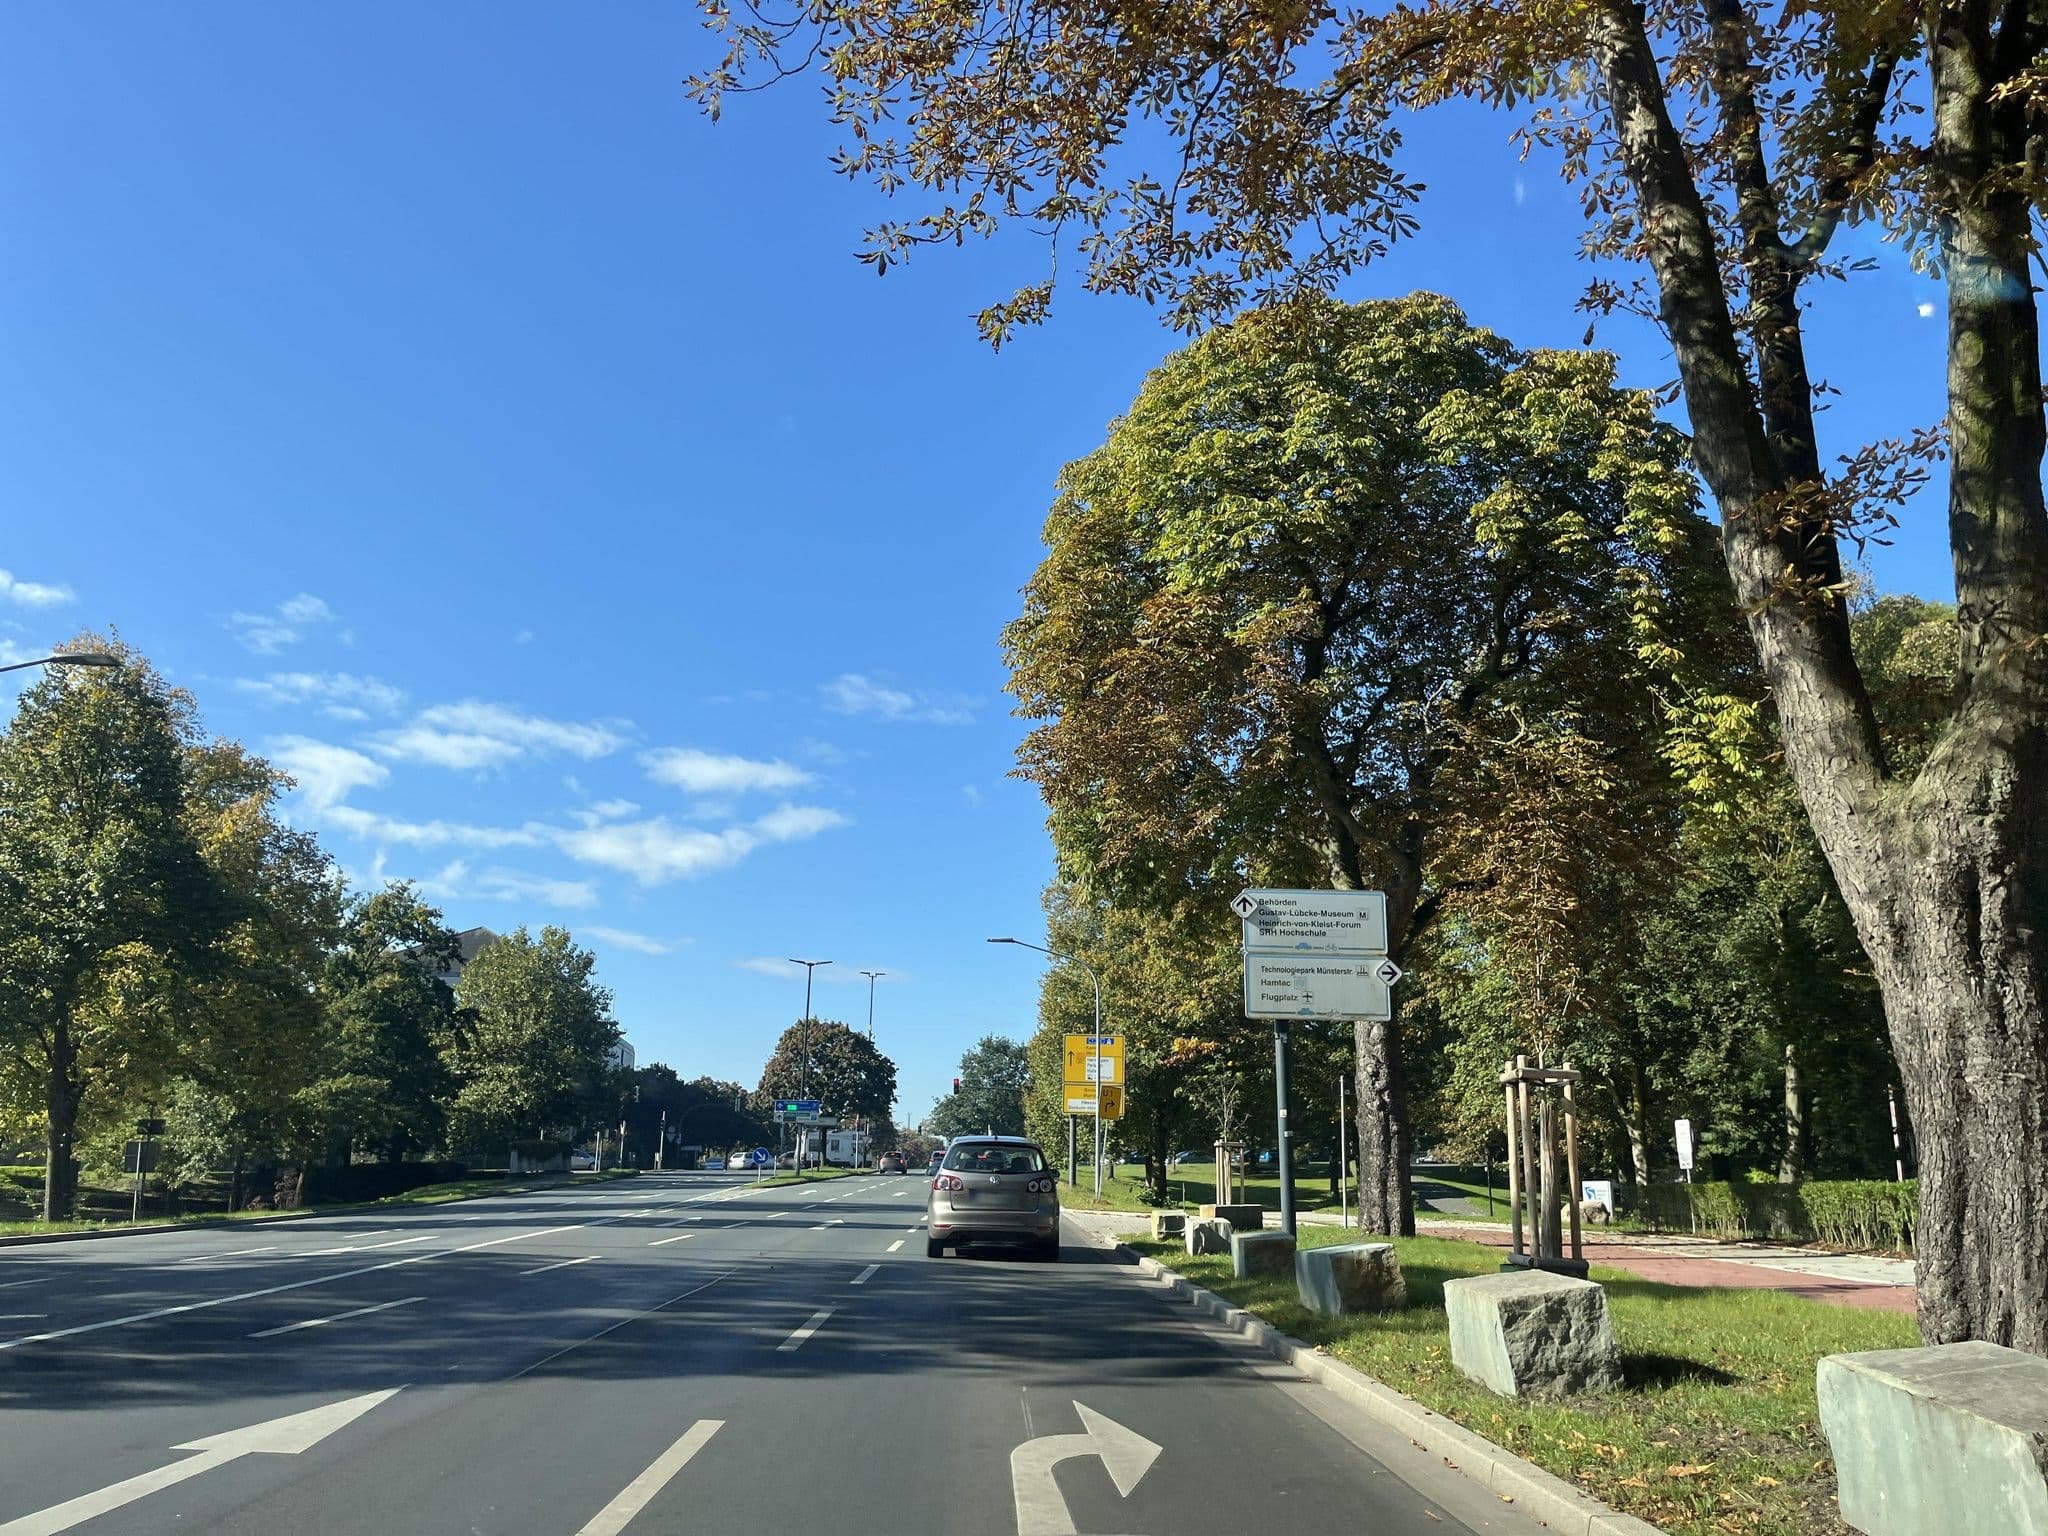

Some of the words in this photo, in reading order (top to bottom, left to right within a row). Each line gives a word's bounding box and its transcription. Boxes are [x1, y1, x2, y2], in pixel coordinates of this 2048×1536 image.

[1259, 898, 1297, 906] Behörden
[1259, 909, 1354, 918] Gustav-Lübcke-Museum
[1259, 920, 1361, 929] Heinrich-von-Kleist-Forum
[1259, 928, 1277, 936] SRH
[1279, 928, 1327, 937] Hochschule
[1261, 965, 1315, 975] Technologiepark
[1261, 993, 1298, 1002] Flugplatz
